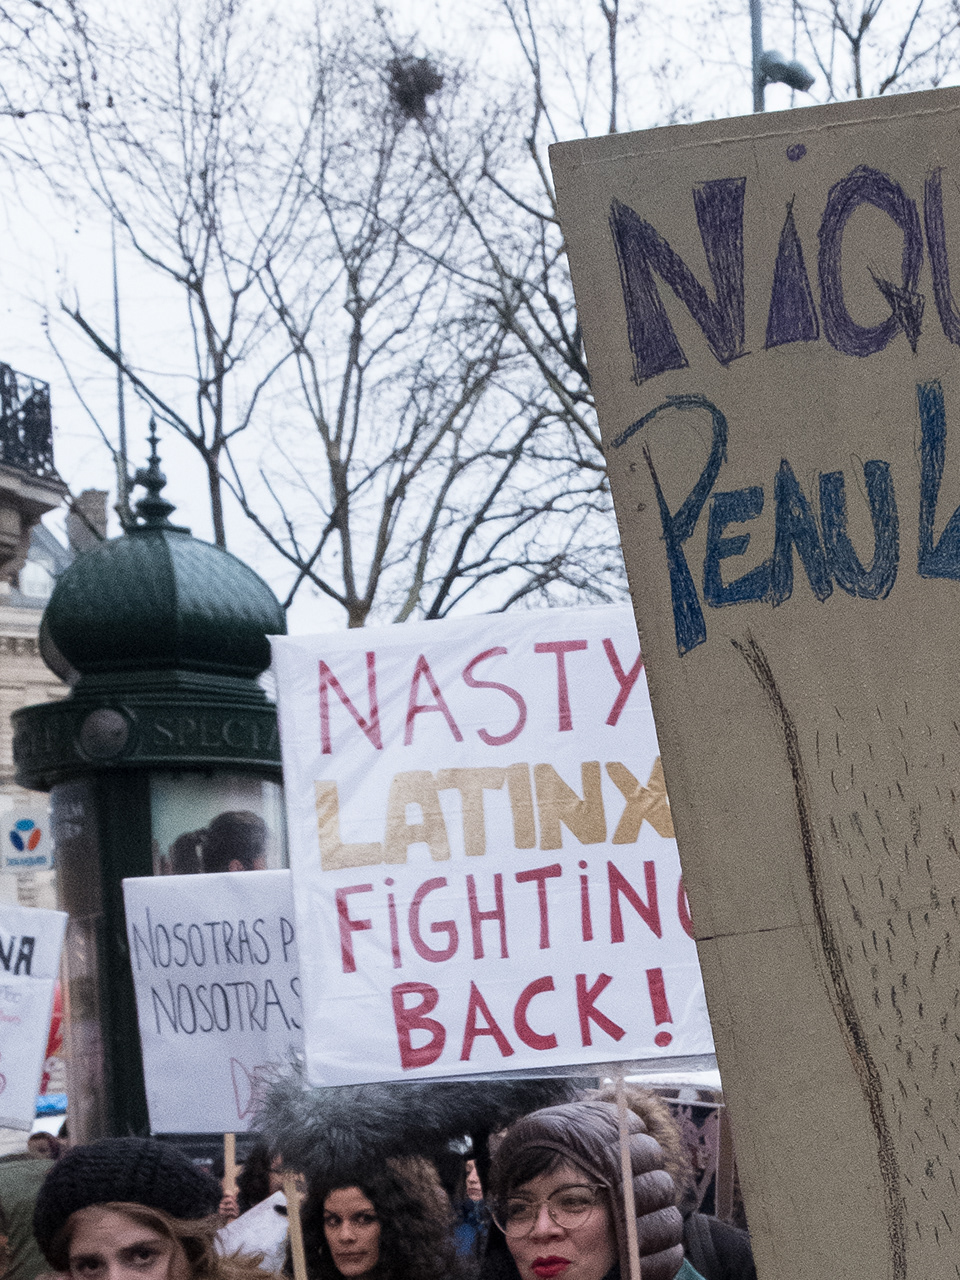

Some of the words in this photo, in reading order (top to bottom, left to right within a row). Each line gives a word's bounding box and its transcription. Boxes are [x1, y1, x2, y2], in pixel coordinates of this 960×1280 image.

[319, 638, 645, 755] NASTY
[132, 906, 270, 970] NOSOTRAS
[390, 967, 673, 1071] BACK!
